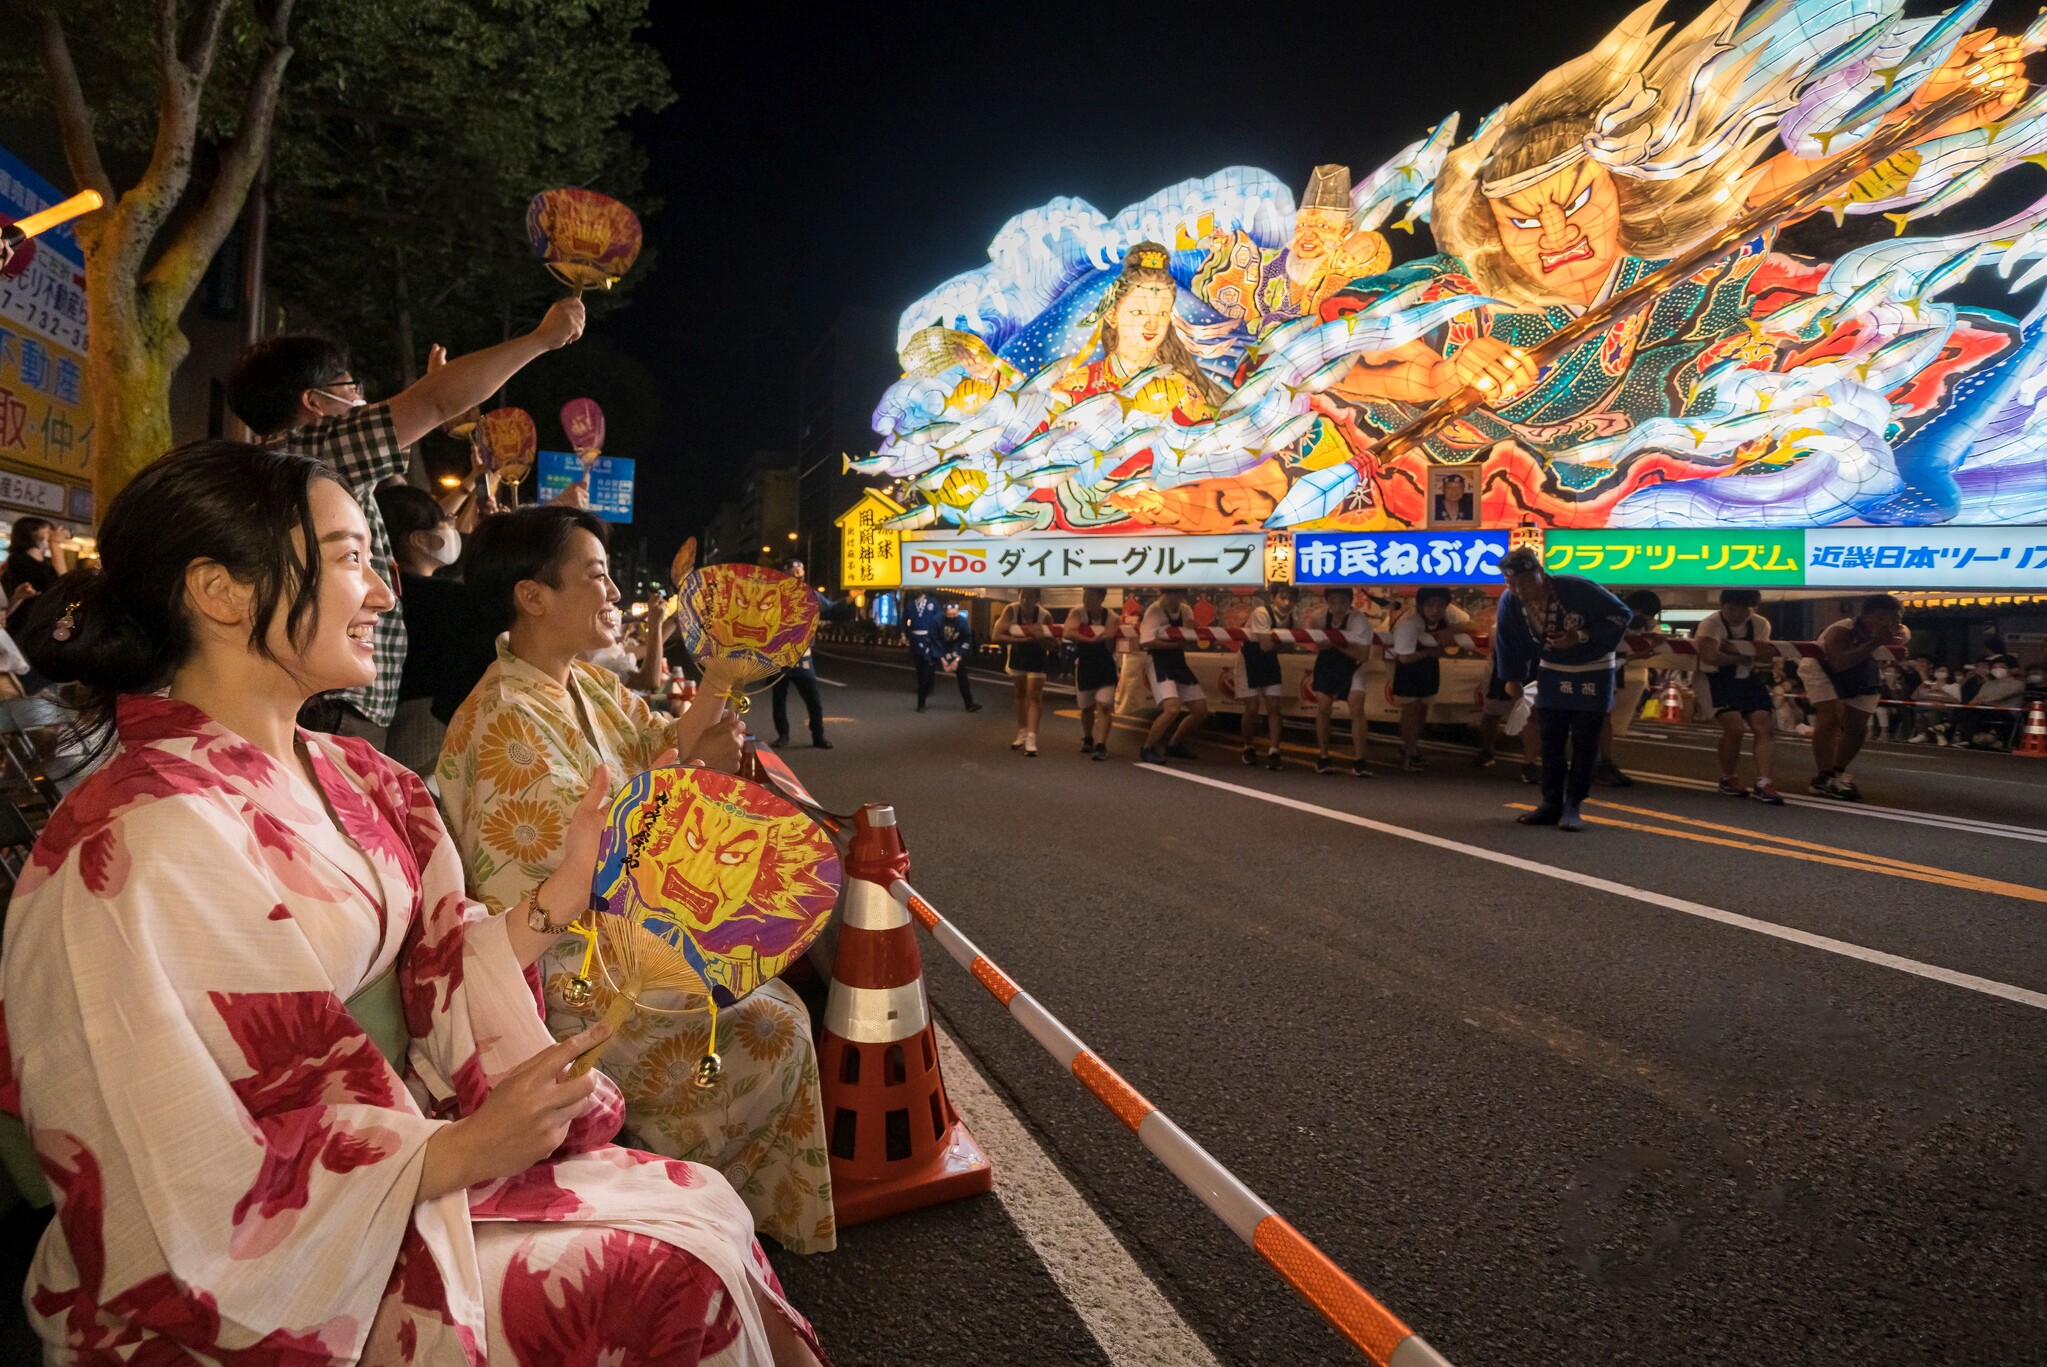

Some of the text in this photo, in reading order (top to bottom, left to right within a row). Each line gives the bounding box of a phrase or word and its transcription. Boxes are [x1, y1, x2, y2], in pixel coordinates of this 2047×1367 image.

[910, 555, 987, 579] DyDo
[998, 543, 1256, 578] ダイドーグループ
[1298, 538, 1506, 578] 市民ねぶた
[1545, 544, 1799, 571] クラブツーリズム
